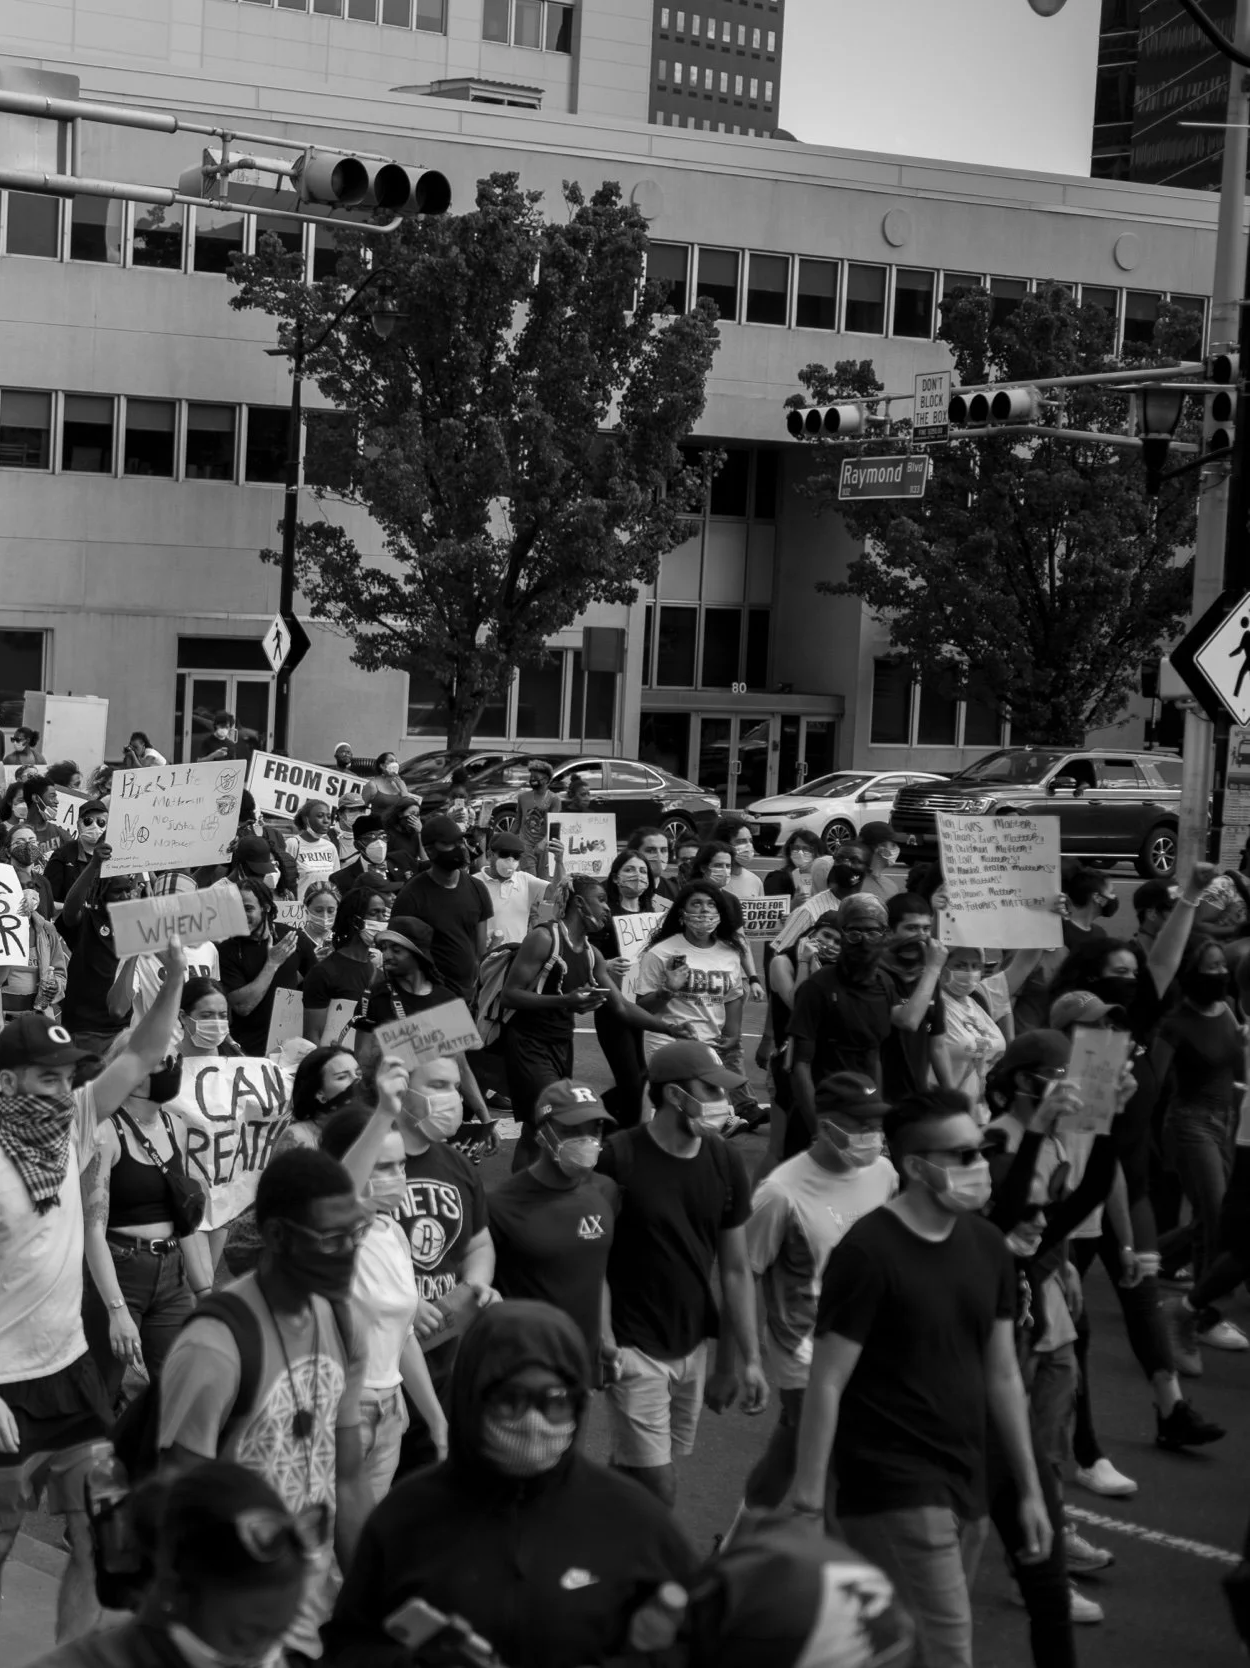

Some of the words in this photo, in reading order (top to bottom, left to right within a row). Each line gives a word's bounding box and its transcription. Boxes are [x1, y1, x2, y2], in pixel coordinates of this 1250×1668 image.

[921, 394, 943, 408] BLOCK
[916, 412, 929, 425] THE
[933, 410, 948, 423] BOX
[843, 463, 903, 489] Raymond
[907, 462, 924, 472] Blvd
[731, 682, 747, 694] 80
[263, 759, 323, 792] FROM
[274, 789, 299, 814] TO
[568, 836, 607, 855] Lives
[300, 852, 333, 863] PRIME
[741, 901, 768, 910] STICE
[768, 901, 784, 909] FOR
[742, 909, 785, 920] EORGE
[137, 905, 217, 944] WHEN?
[381, 1023, 421, 1044] BLACK
[438, 1031, 482, 1055] MATTER
[195, 1064, 286, 1122] CAN
[571, 1087, 597, 1102] R
[185, 1119, 290, 1188] REATH
